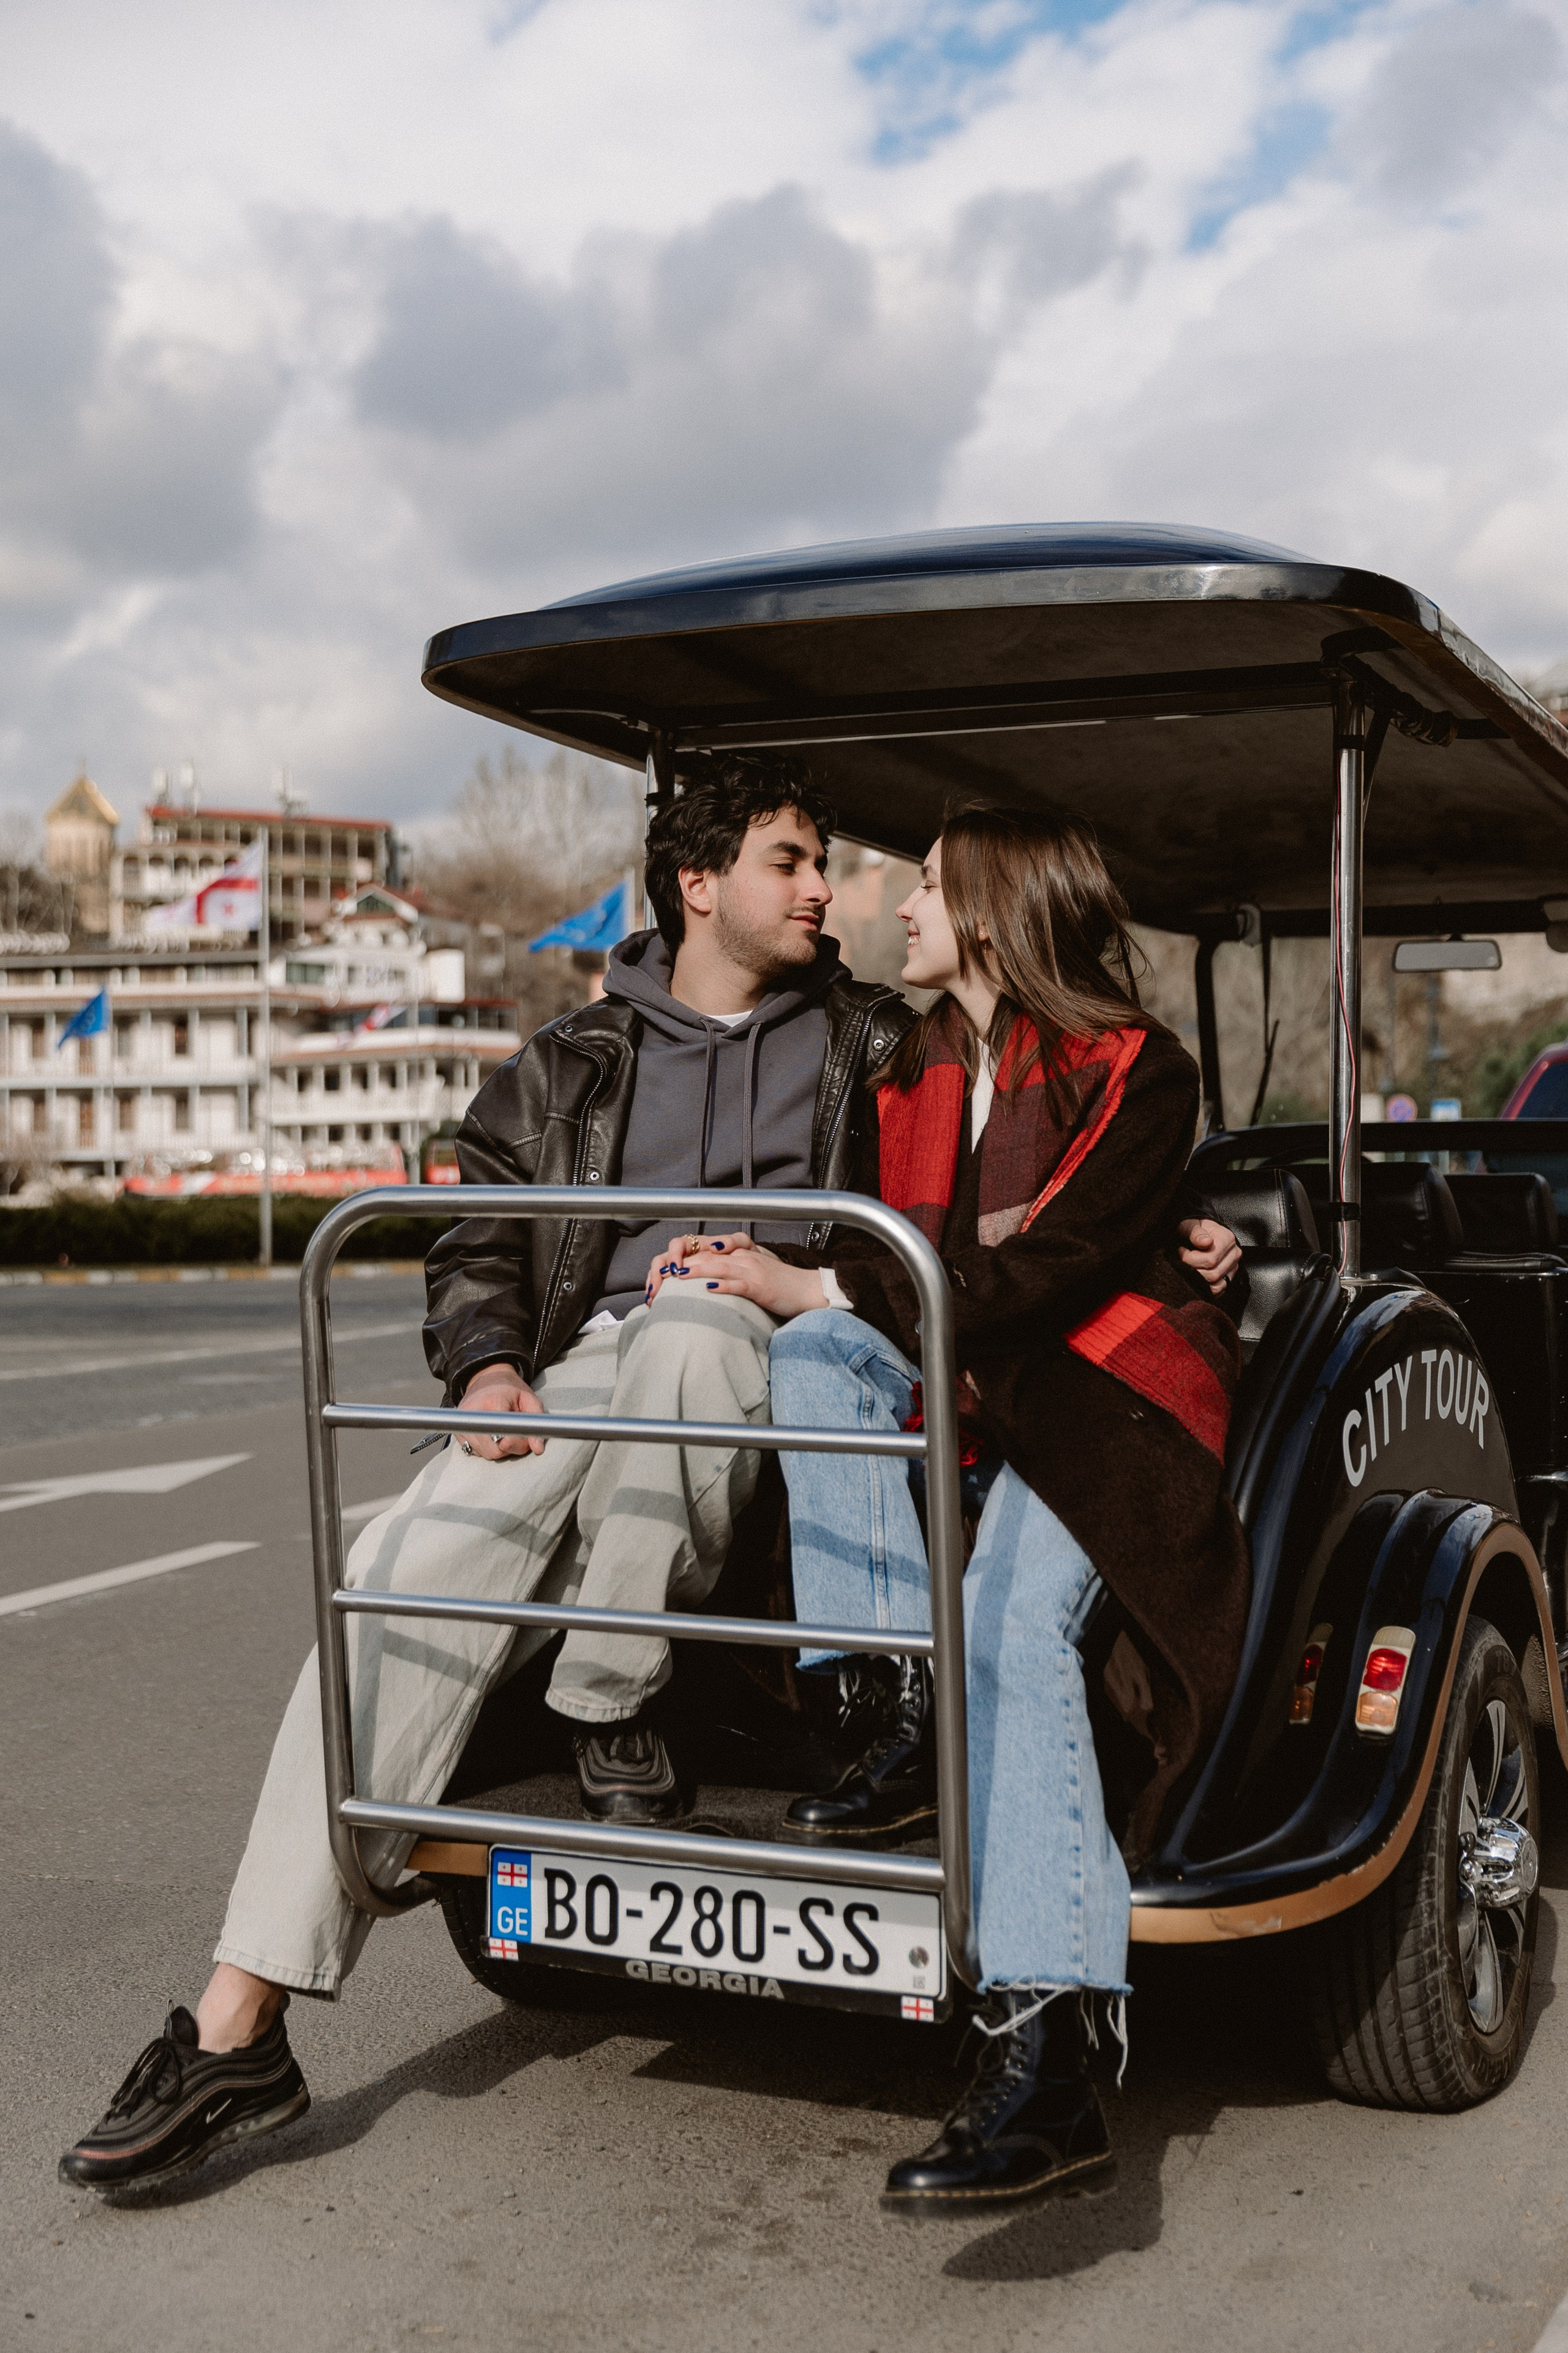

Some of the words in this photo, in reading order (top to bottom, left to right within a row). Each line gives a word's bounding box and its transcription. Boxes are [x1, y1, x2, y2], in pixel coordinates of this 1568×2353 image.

[1343, 1355, 1413, 1487] CITY
[1421, 1349, 1490, 1449] TOUR
[497, 1906, 528, 1936] GE
[544, 1867, 880, 1976] BO-280-SS
[625, 1960, 785, 2000] GEORGIA
